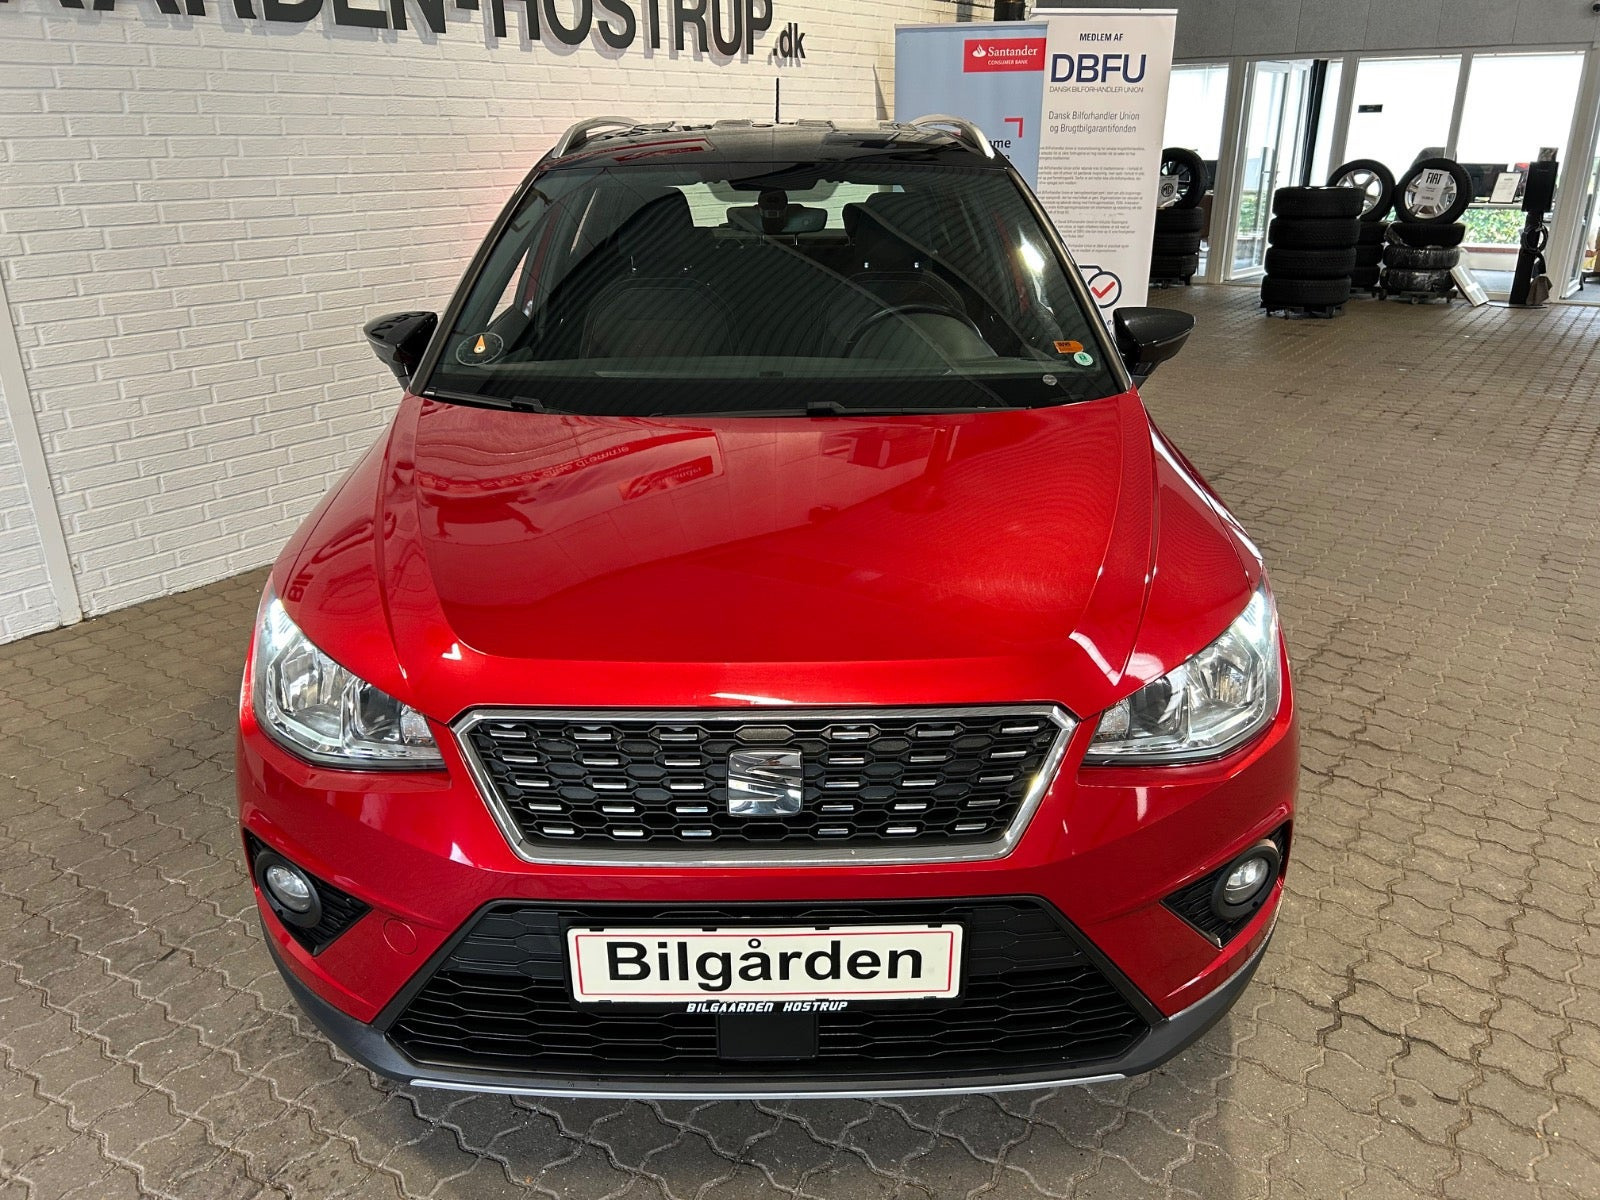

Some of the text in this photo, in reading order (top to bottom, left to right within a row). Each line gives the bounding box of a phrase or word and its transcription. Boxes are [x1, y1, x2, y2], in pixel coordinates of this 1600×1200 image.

[1079, 33, 1124, 42] MEDLEM AF
[987, 45, 1038, 57] Santander
[1050, 53, 1147, 83] DBFU
[1048, 111, 1140, 121] Dansk Bilforhandler Union
[1049, 123, 1137, 135] og Brugtbilgarantifonden
[1426, 172, 1443, 185] FIAT
[605, 938, 923, 992] Bilgården
[686, 1001, 849, 1014] BILGAARDEN HOSTRUP
